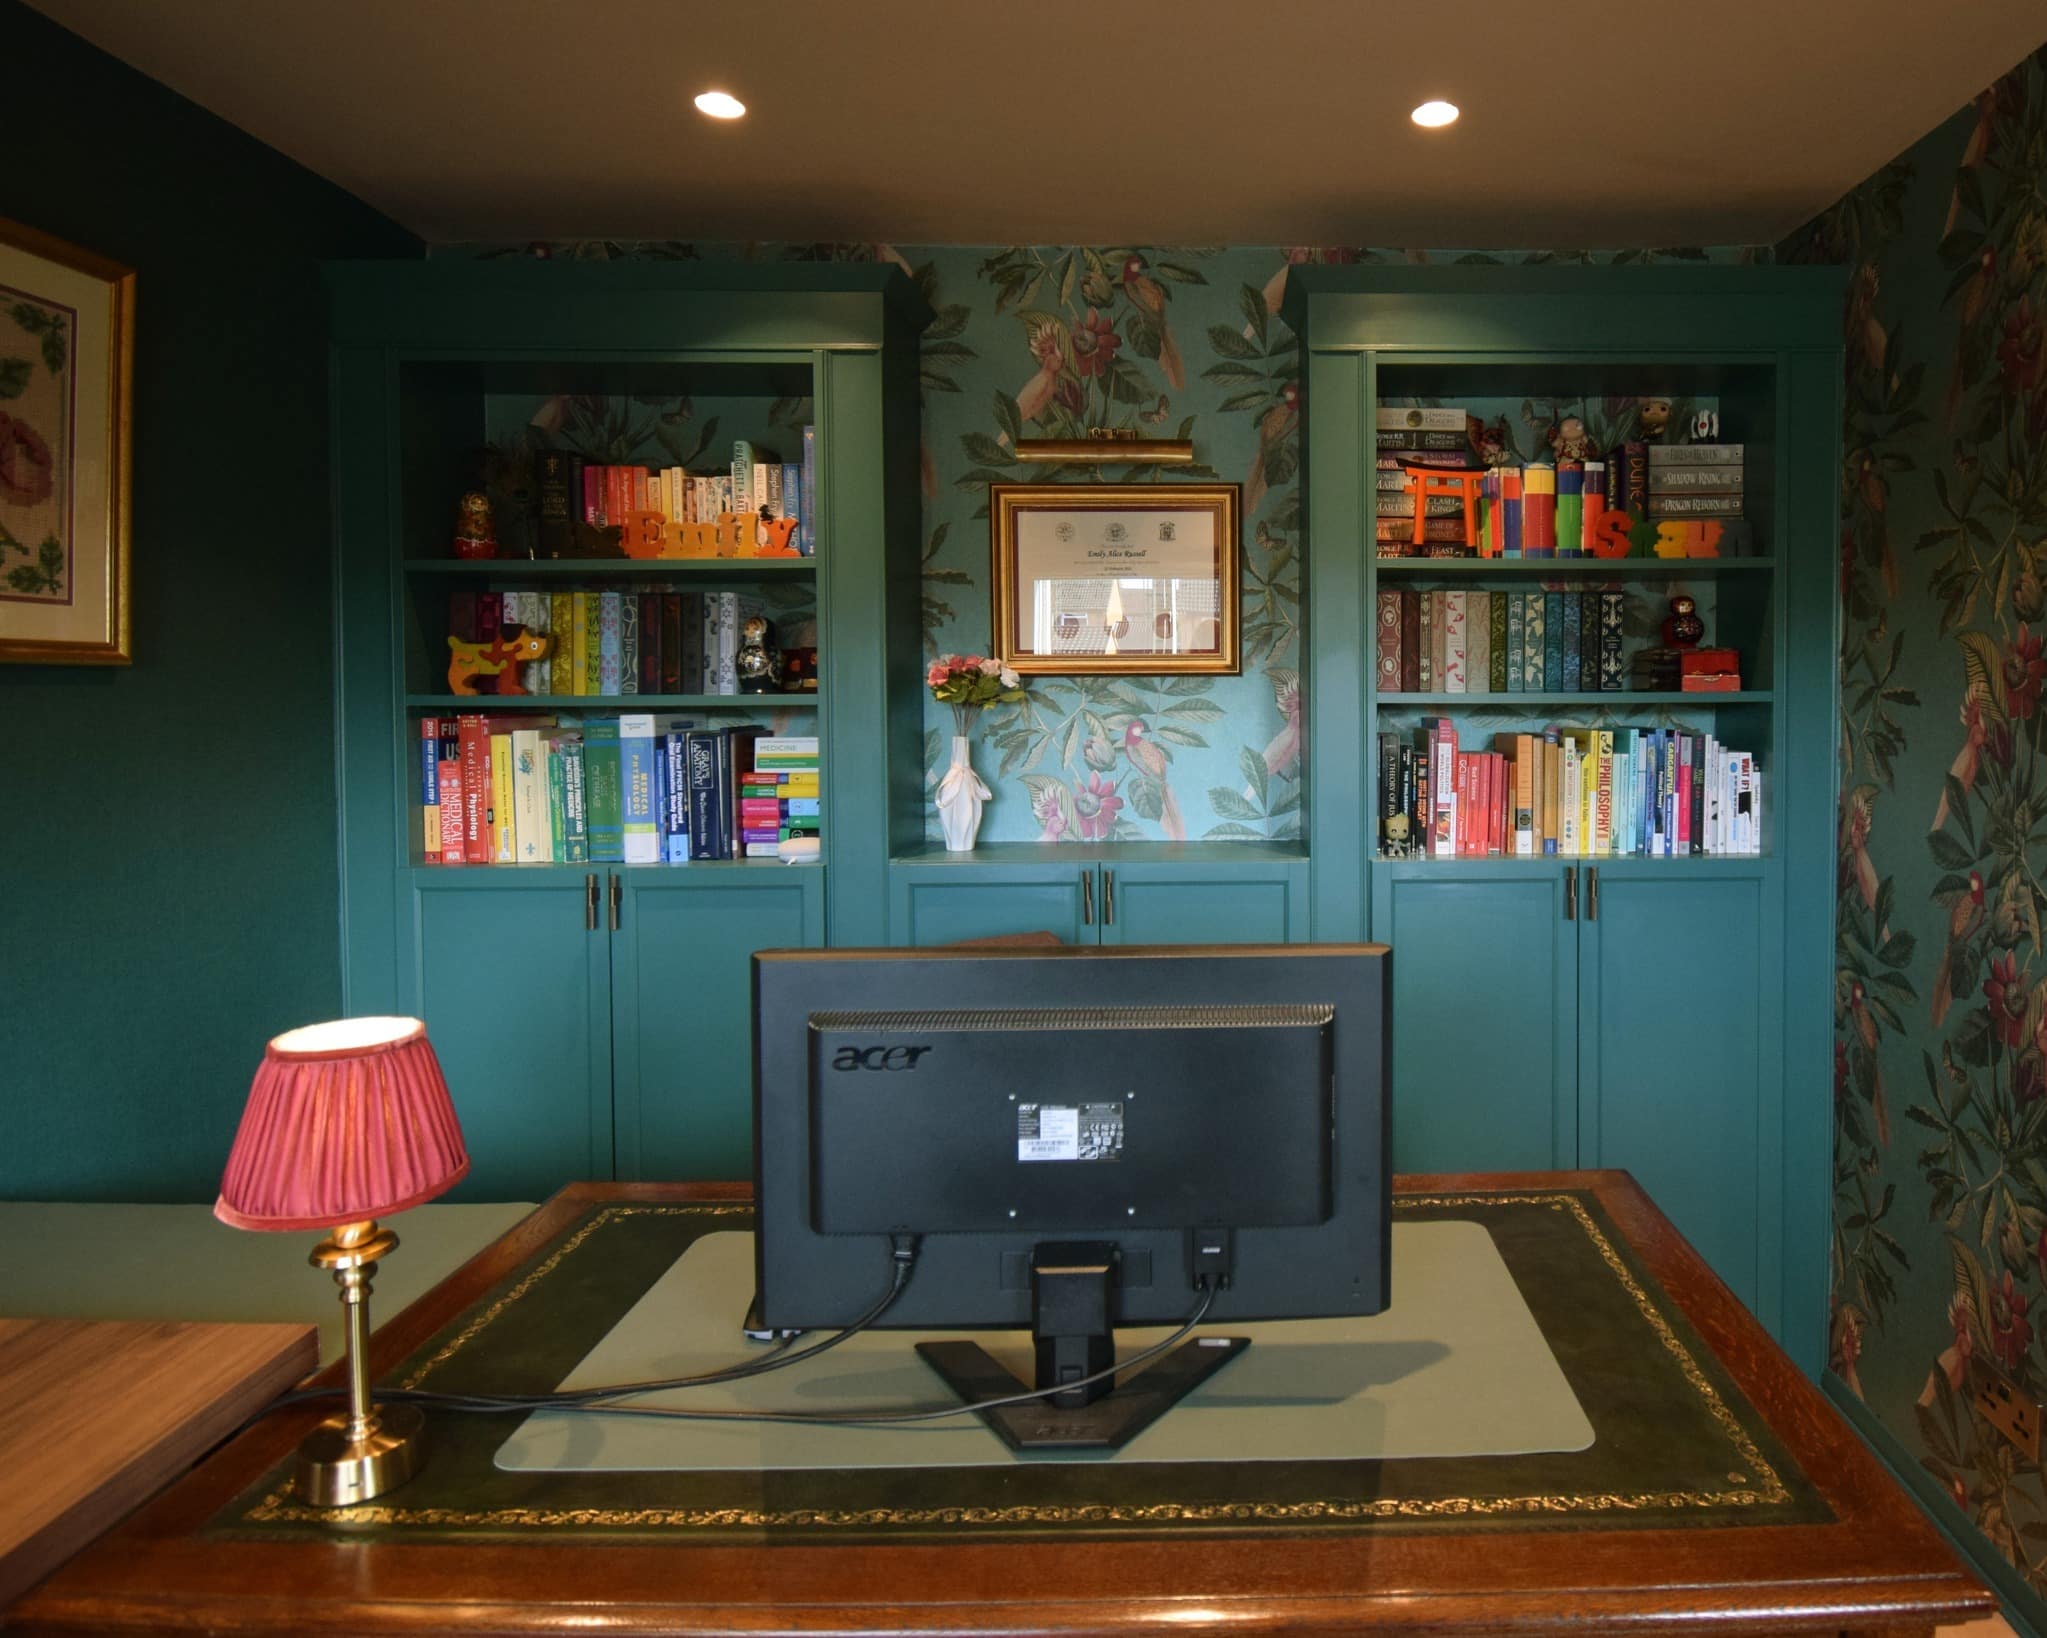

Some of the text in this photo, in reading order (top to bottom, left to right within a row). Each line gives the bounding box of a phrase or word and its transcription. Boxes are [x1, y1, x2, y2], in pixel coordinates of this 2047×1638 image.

[622, 510, 801, 560] Emily
[692, 743, 704, 786] ANATOMY
[759, 743, 797, 752] MEDICINE
[1666, 741, 1675, 796] GARGANTUA
[1741, 757, 1750, 777] WHAT
[466, 741, 480, 841] Medical Physiology
[640, 772, 649, 816] MEDICAL
[1387, 763, 1396, 793] THEORY
[1388, 793, 1396, 804] OF
[1597, 764, 1613, 833] PHILOSOPHY
[439, 792, 453, 846] DICTIONARY
[449, 792, 464, 845] MEDICAL
[832, 1046, 932, 1072] acer
